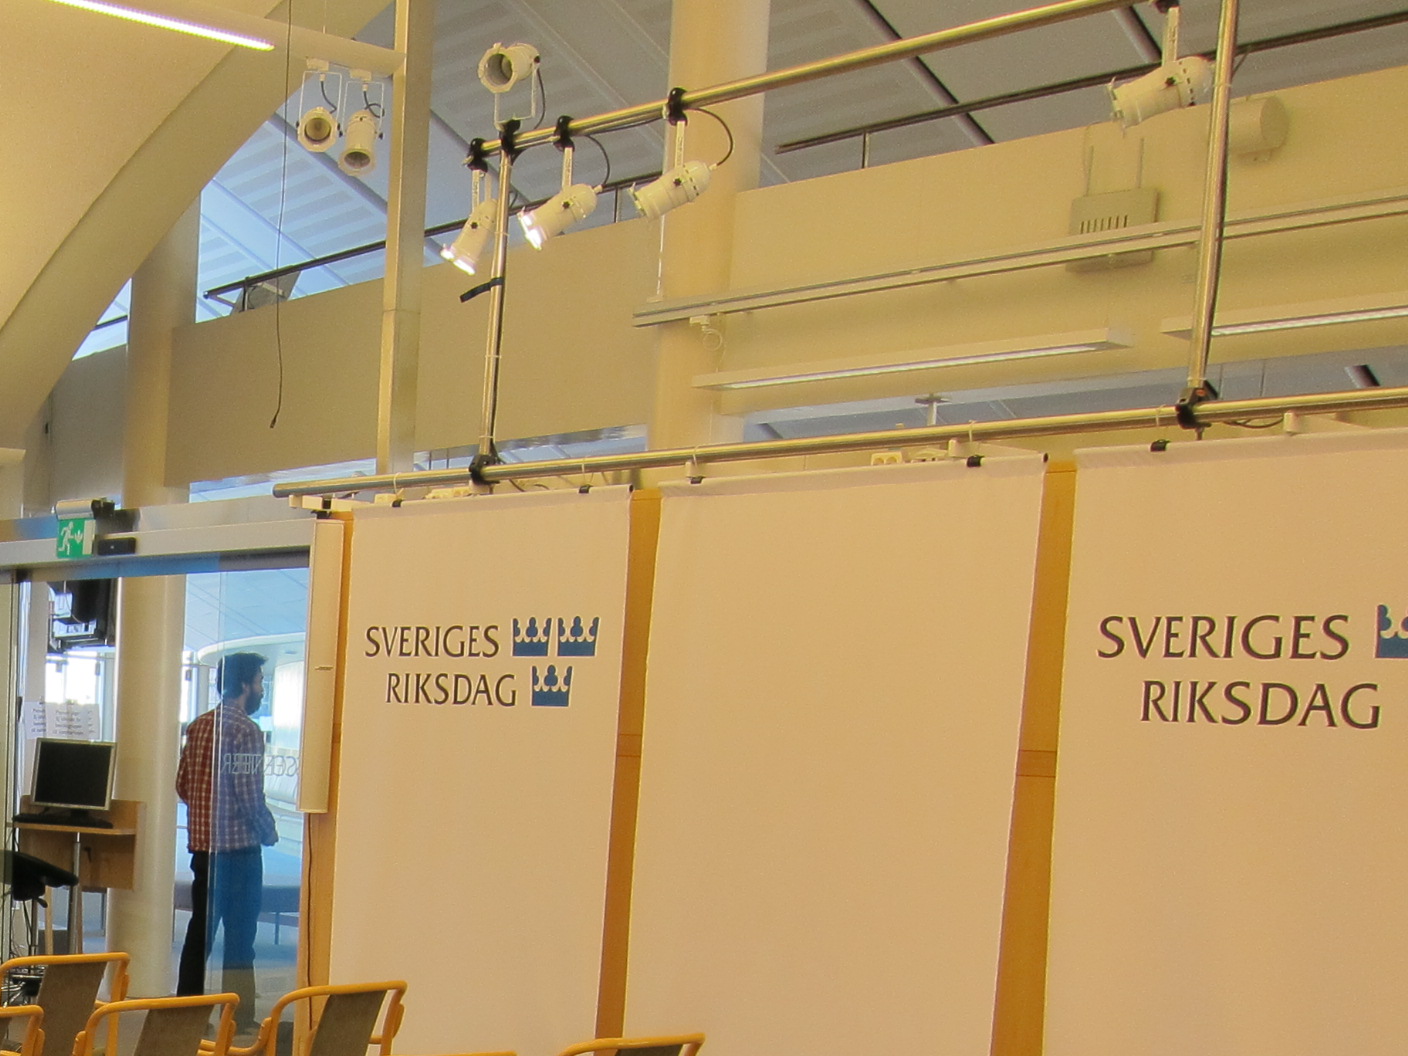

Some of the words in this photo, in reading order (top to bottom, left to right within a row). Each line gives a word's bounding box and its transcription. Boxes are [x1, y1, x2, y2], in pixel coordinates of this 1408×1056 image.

[365, 625, 500, 658] SVERIGES
[1097, 615, 1349, 660] SVERIGES
[386, 673, 517, 707] RIKSDAG
[1140, 680, 1381, 729] RIKSDAG
